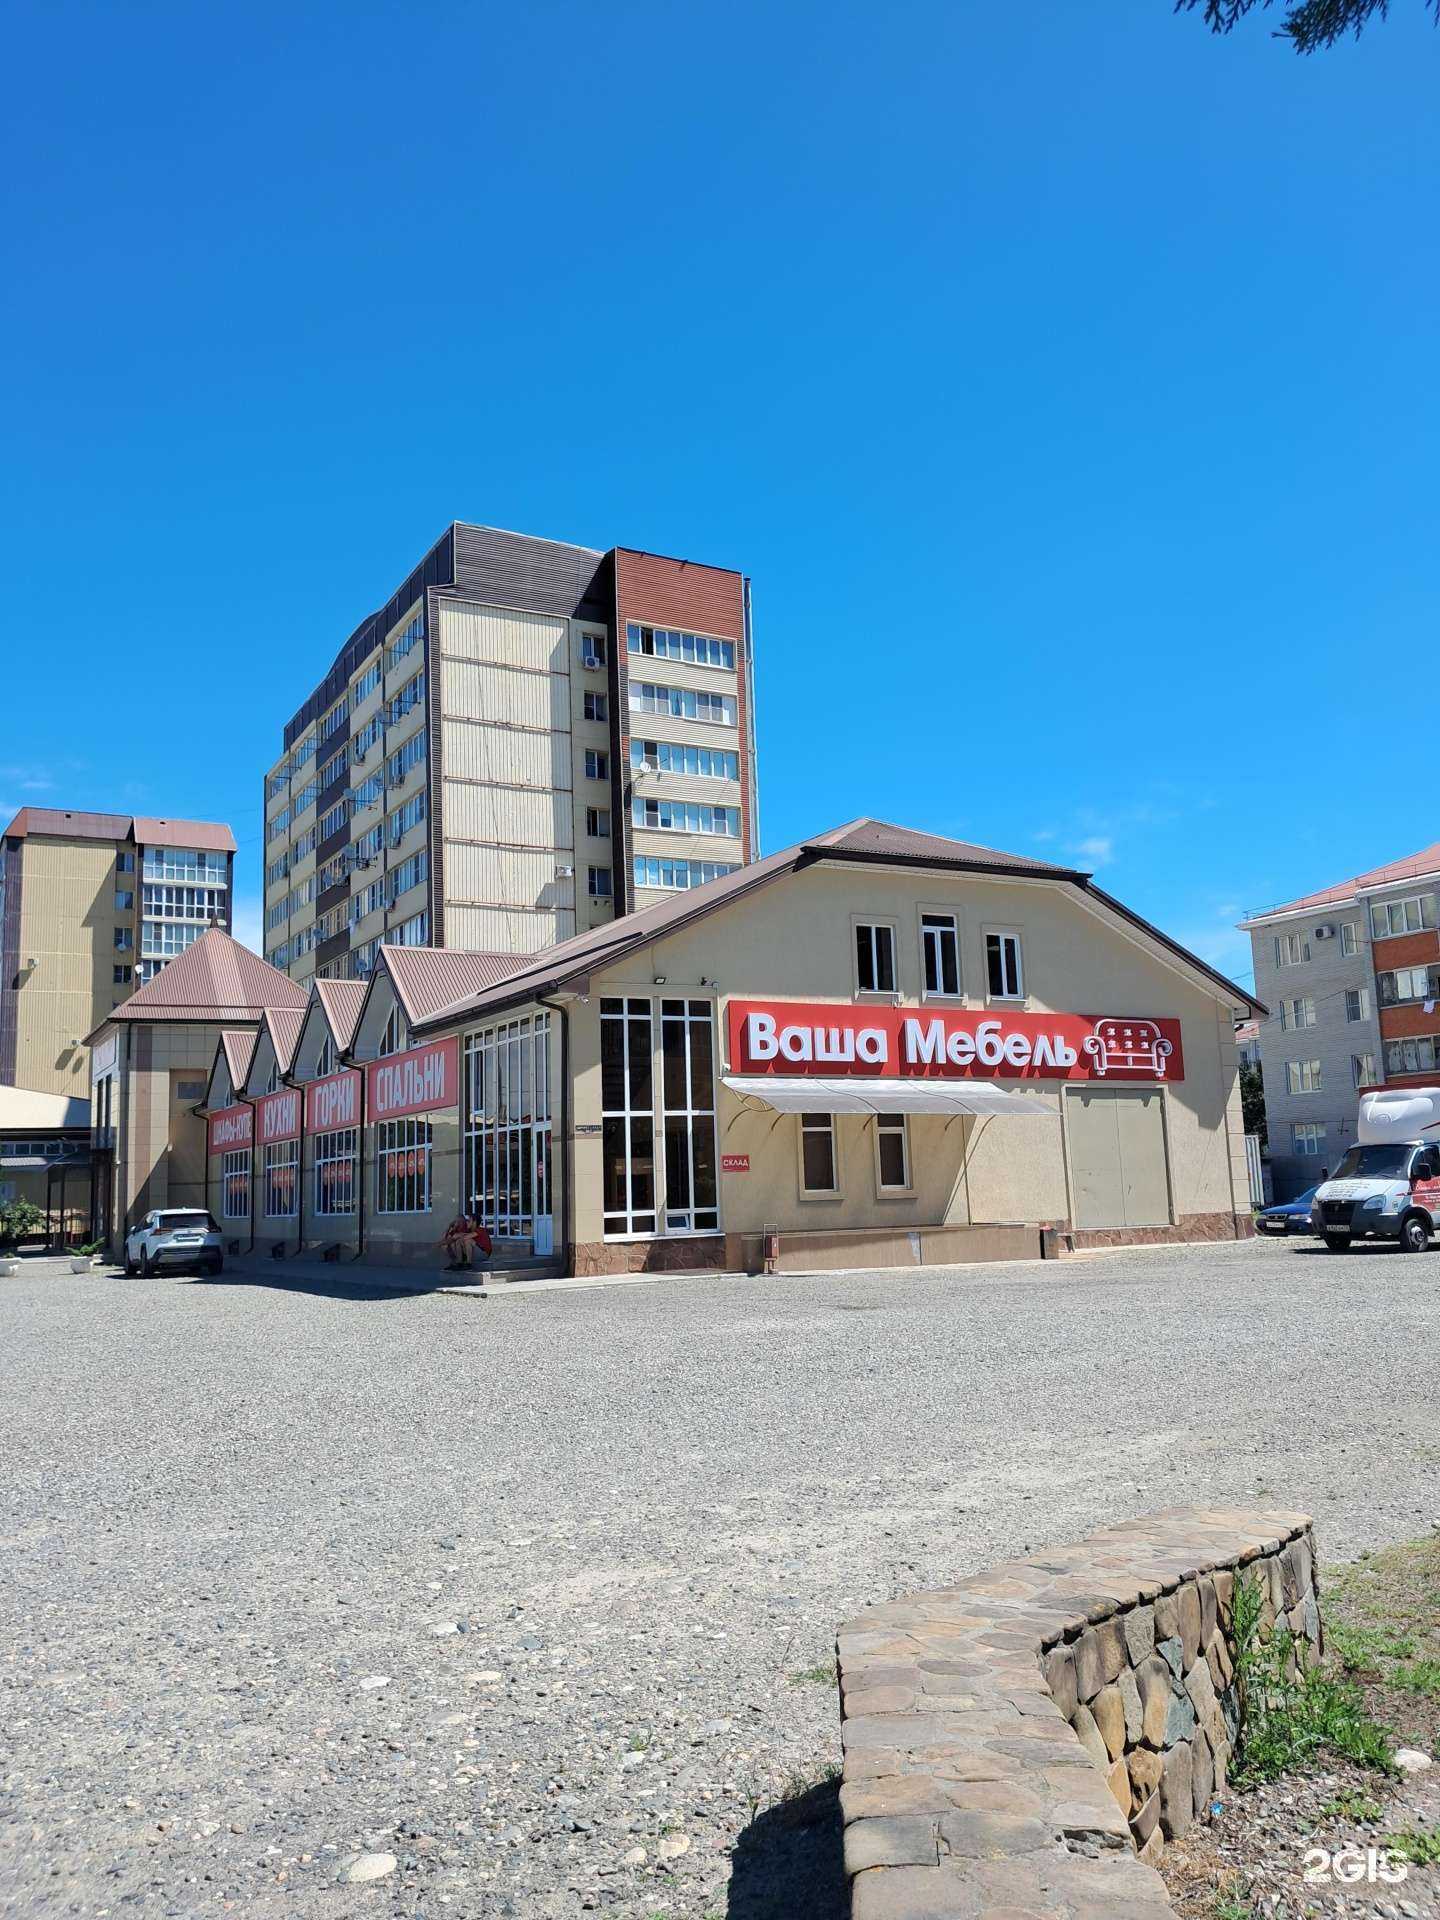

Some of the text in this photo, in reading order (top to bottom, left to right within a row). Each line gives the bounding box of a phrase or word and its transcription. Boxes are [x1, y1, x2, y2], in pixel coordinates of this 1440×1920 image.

[746, 1012, 1078, 1067] Ваша Мебель
[313, 1075, 355, 1126] ГОРКИ
[376, 1051, 445, 1112] СПАЛЬНИ
[264, 1093, 296, 1138] КУХНИ
[723, 1159, 748, 1168] СКЛАД
